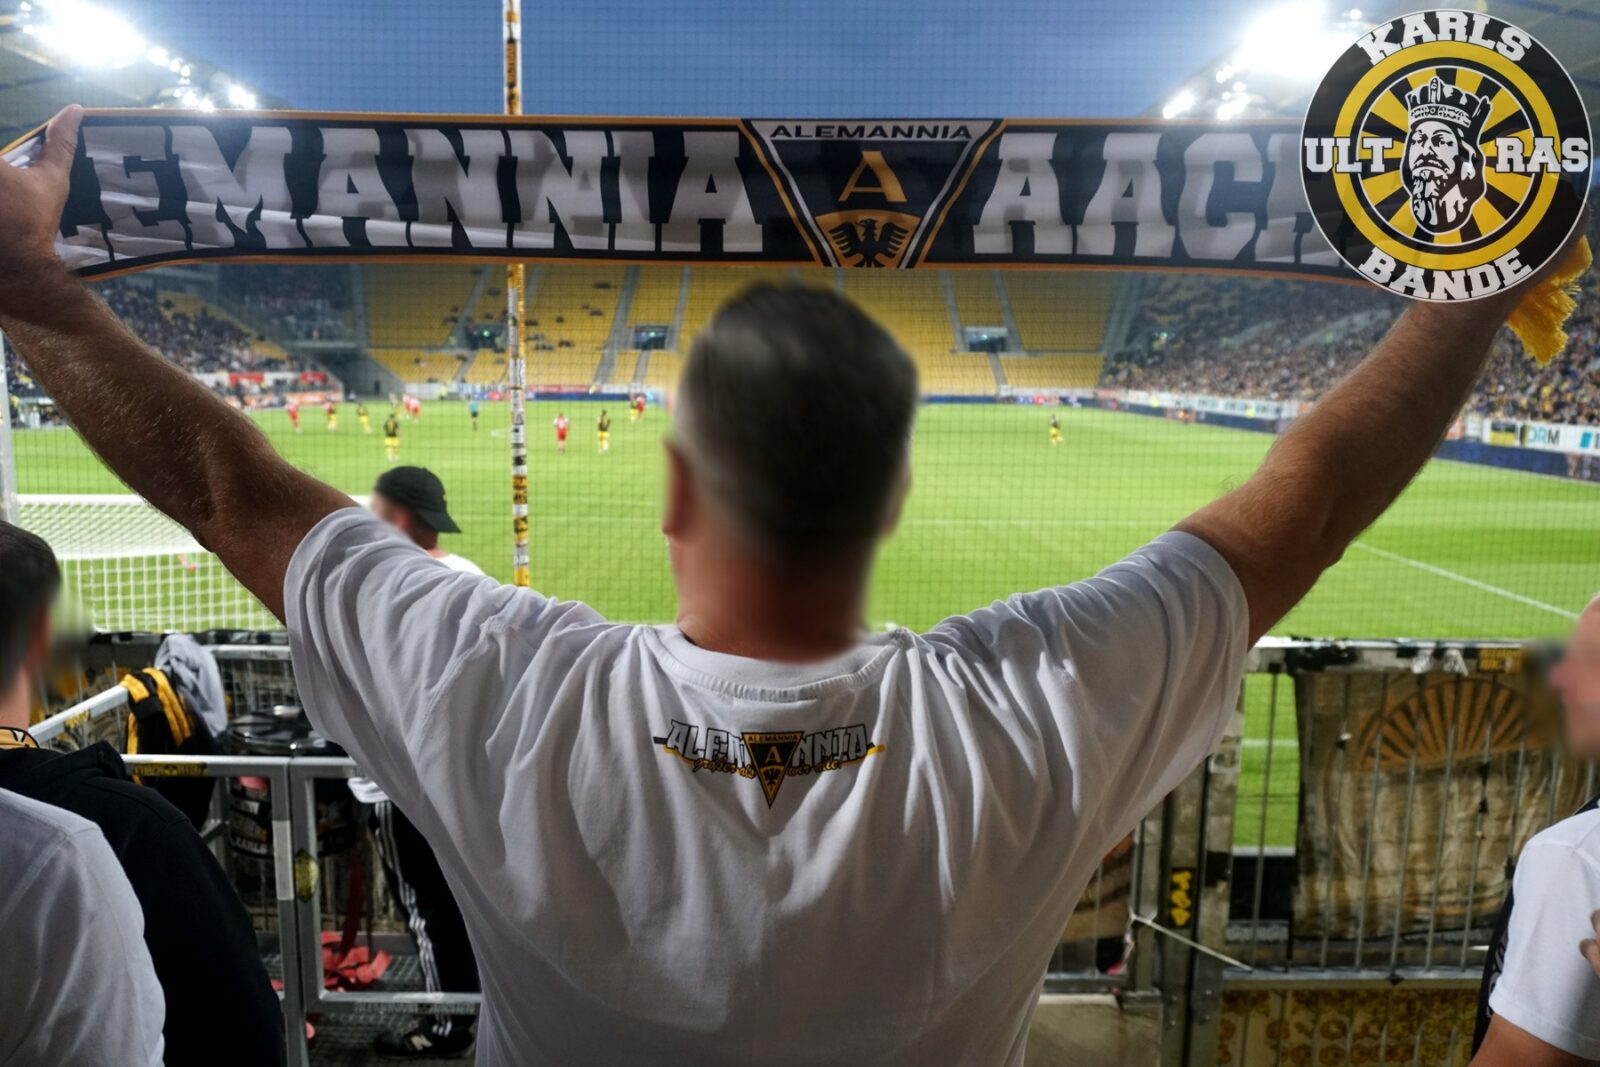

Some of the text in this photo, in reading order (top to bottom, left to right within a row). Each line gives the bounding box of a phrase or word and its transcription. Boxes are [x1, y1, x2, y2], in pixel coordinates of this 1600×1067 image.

[769, 125, 973, 139] ALEMANNIA
[838, 150, 908, 202] A
[764, 745, 782, 763] A
